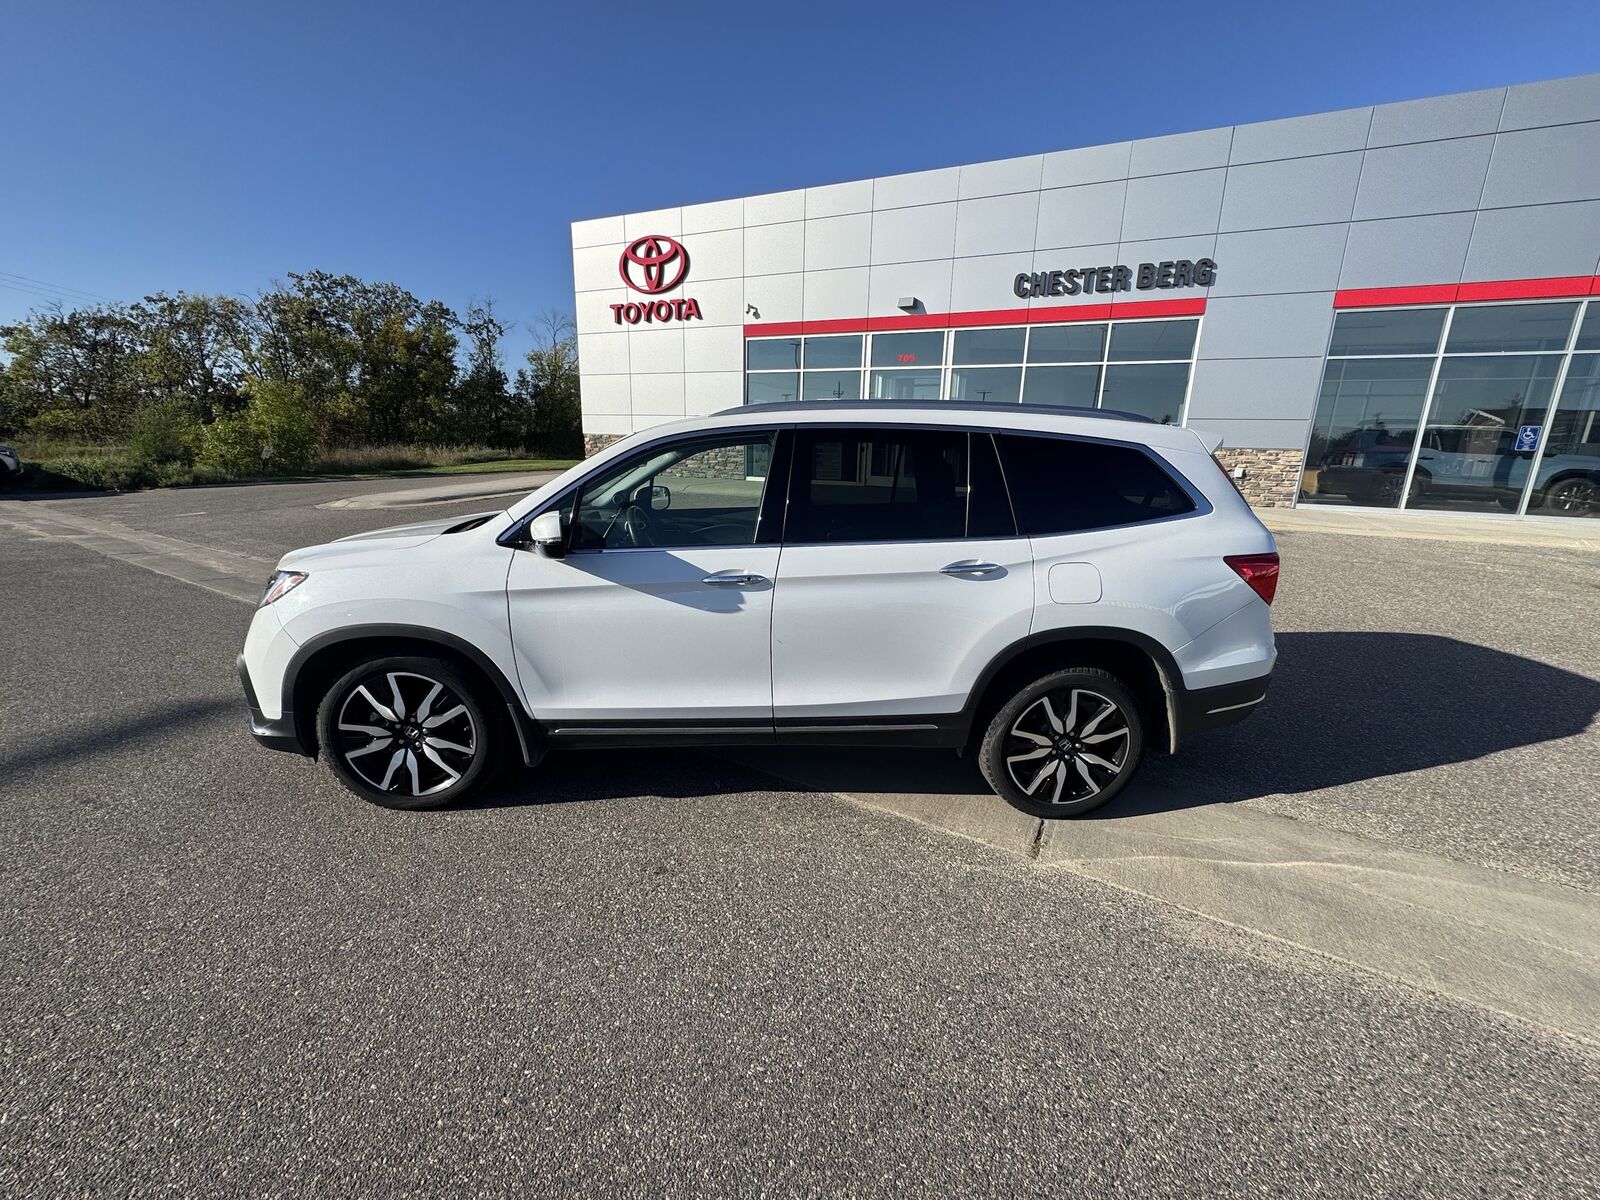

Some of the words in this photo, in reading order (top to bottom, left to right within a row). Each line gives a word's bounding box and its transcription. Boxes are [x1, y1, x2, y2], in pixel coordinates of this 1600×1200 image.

[1013, 264, 1132, 299] CHESTER
[1136, 258, 1217, 288] BERG
[609, 298, 703, 325] TOYOTA
